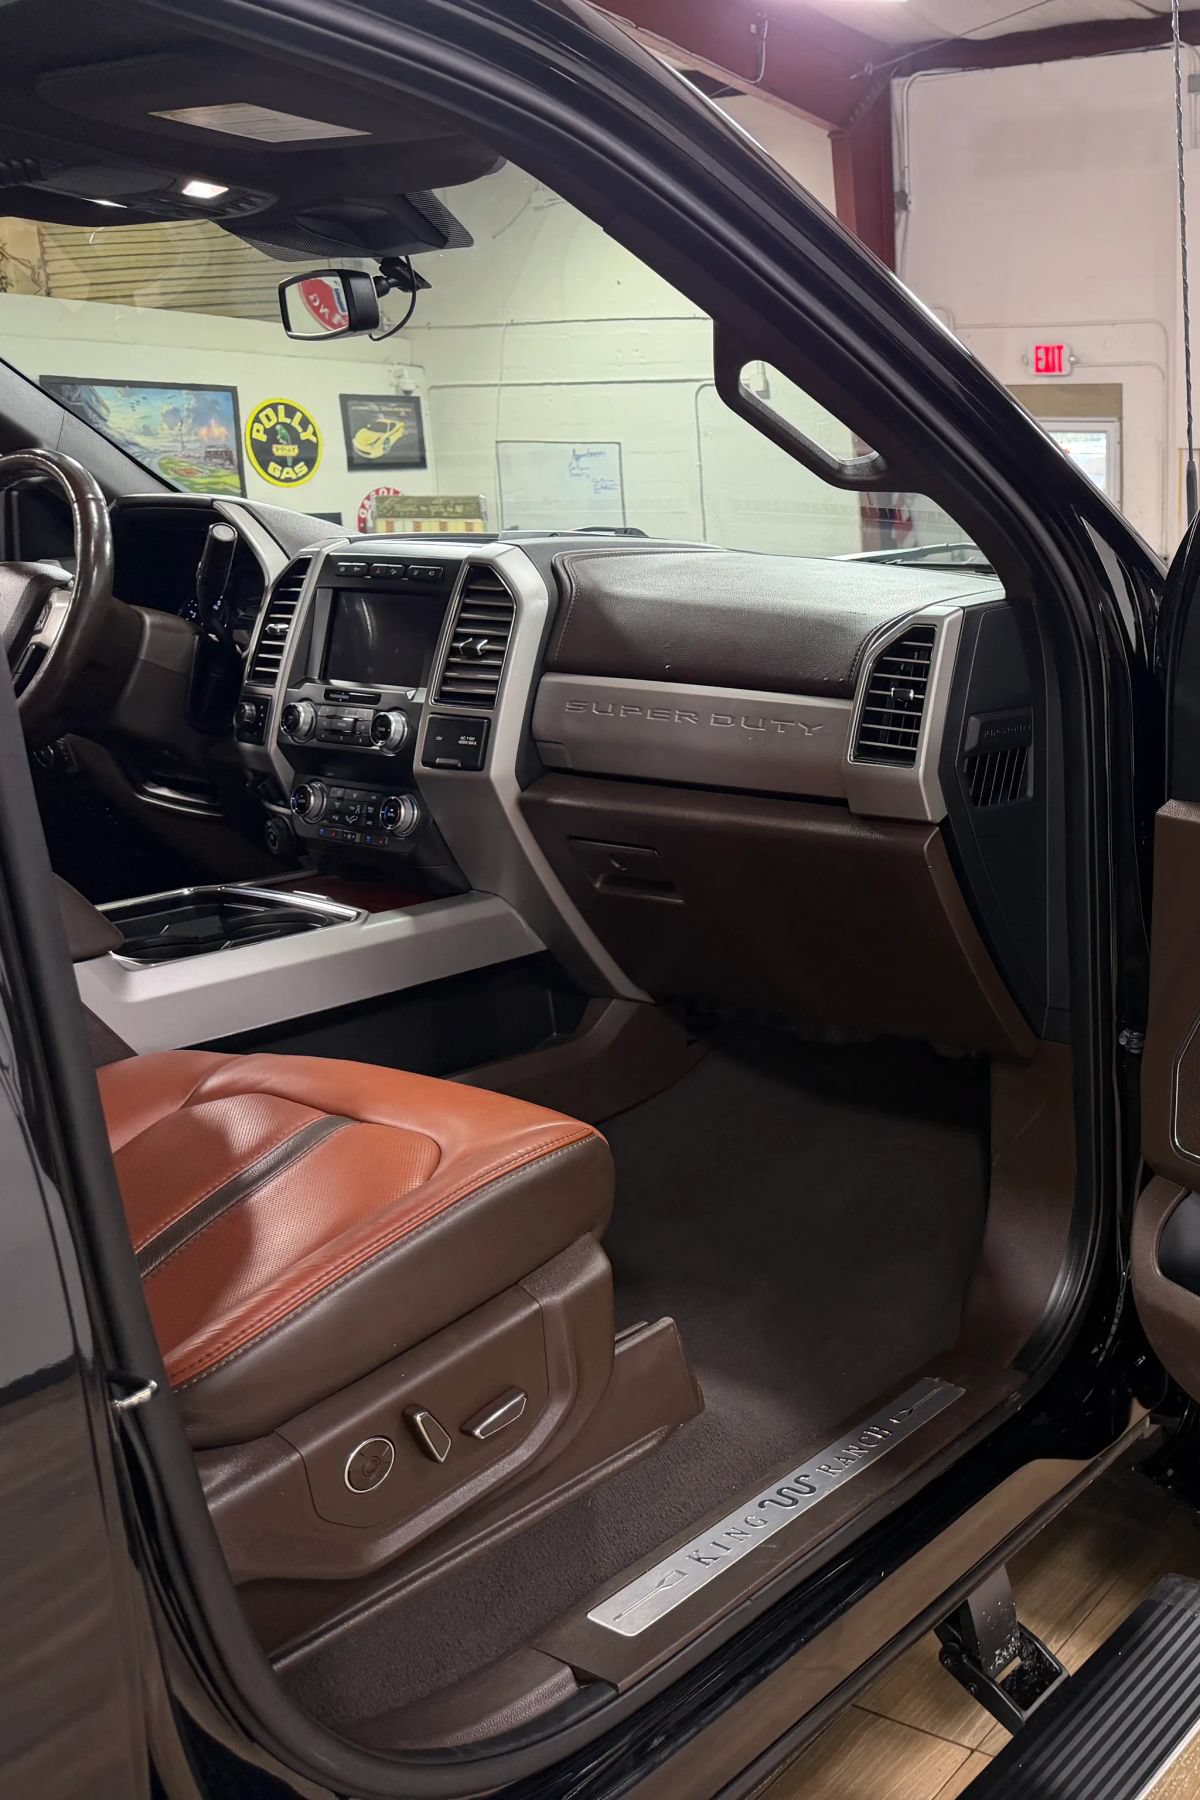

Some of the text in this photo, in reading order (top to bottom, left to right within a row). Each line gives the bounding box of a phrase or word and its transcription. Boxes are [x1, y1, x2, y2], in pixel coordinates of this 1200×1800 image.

[1035, 345, 1064, 373] EXIT
[252, 405, 317, 443] POLLY
[268, 461, 308, 479] GAS
[565, 701, 824, 736] SUPER DUTY
[686, 1424, 892, 1568] KING RANCH
